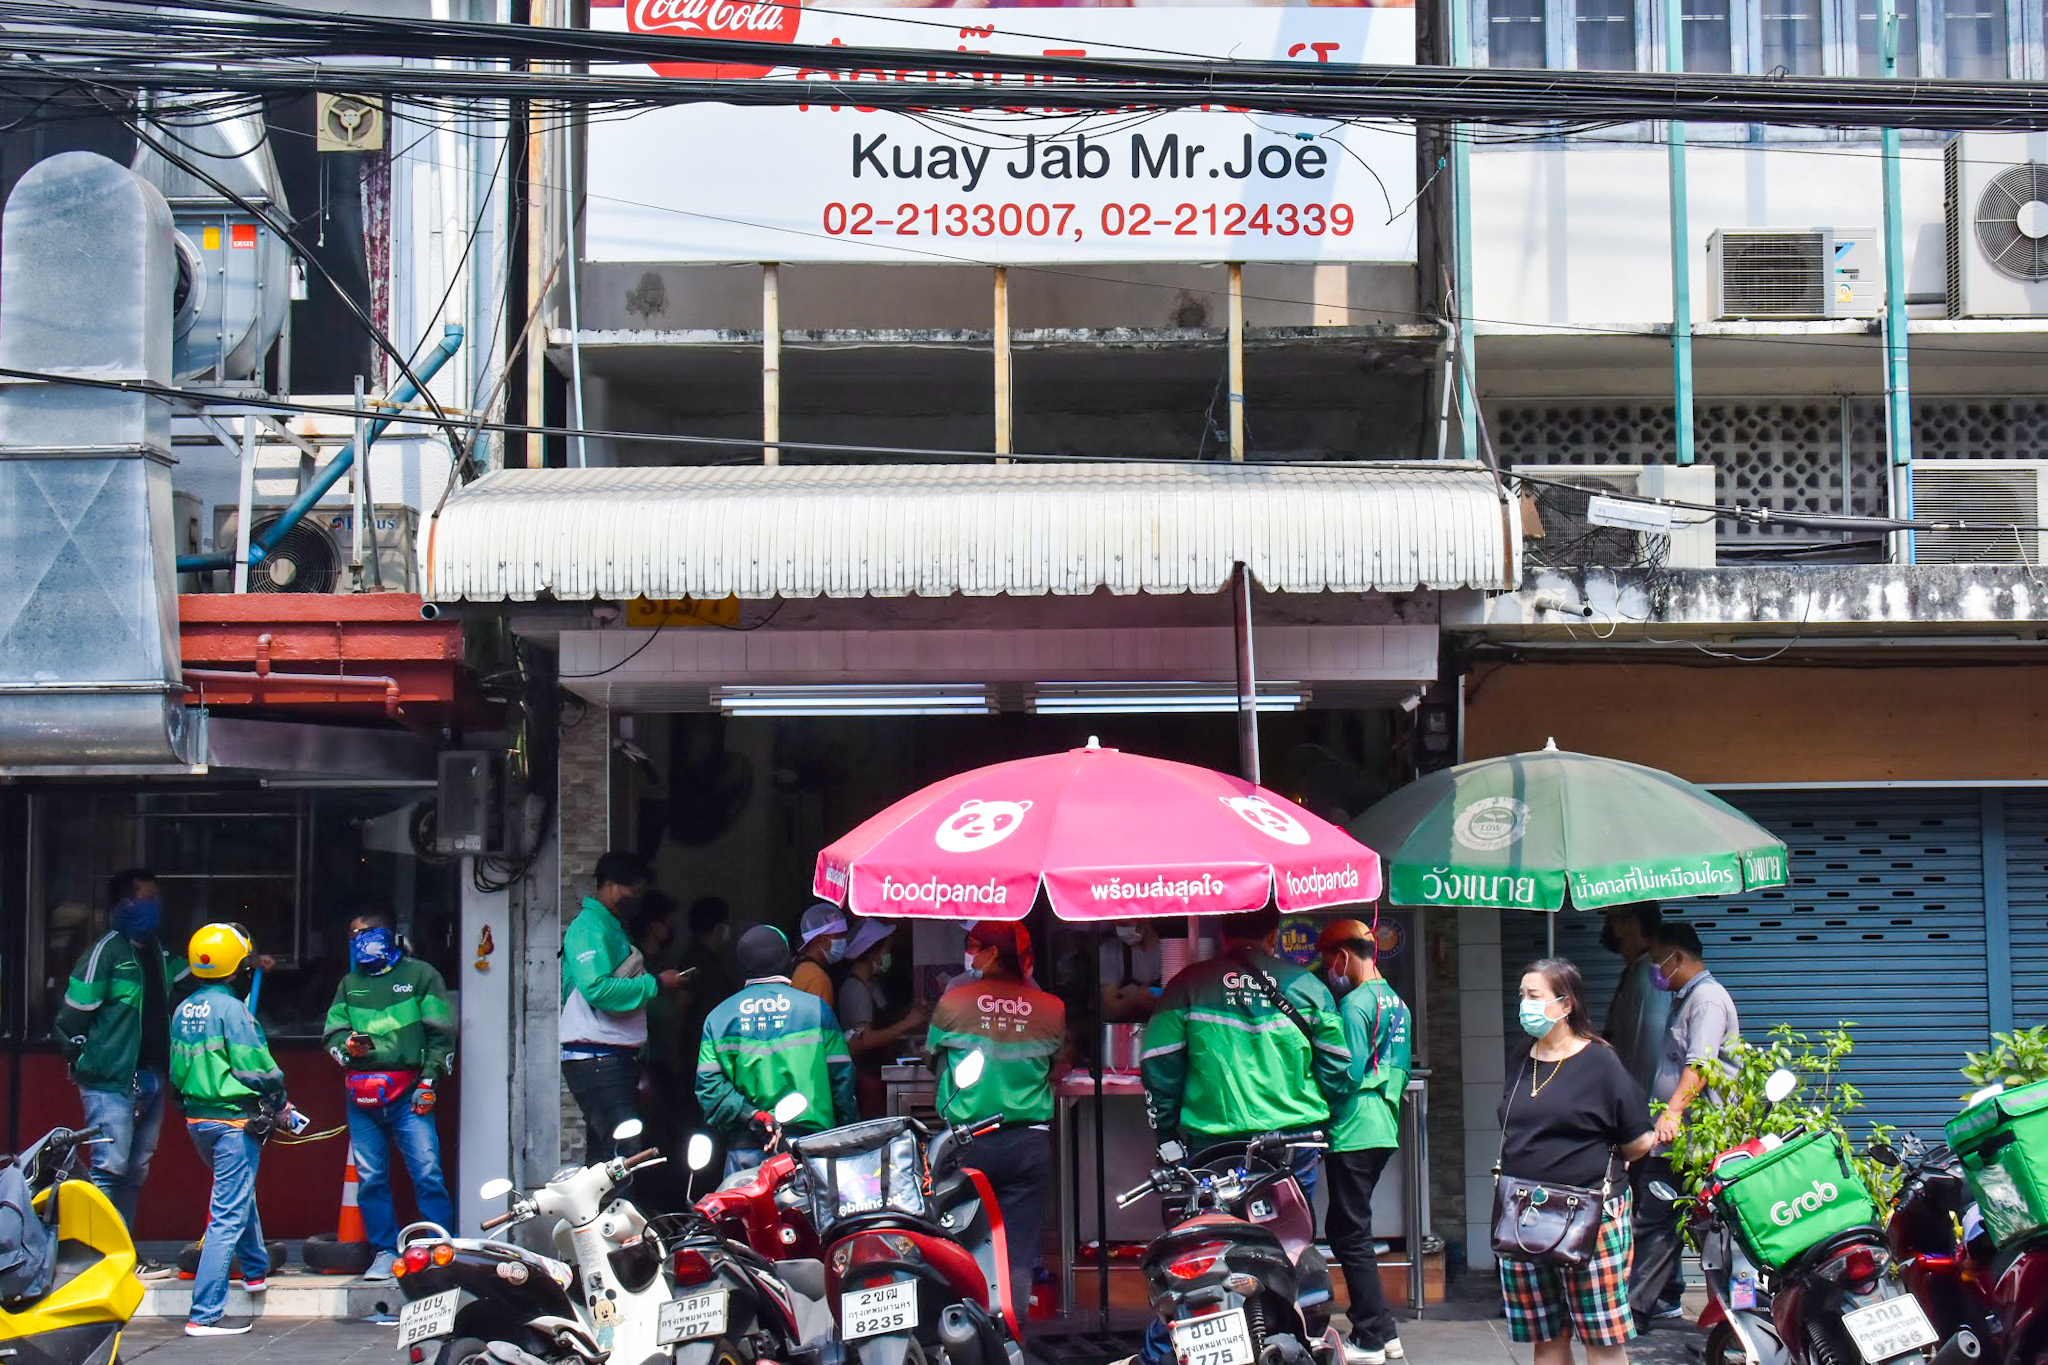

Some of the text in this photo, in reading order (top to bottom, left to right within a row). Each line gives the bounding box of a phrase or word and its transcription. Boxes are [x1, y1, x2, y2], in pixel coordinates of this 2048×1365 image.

[852, 133, 1327, 192] Kuay Jab Mr.Joe
[823, 203, 1354, 243] 02-2133007, 02-2124339
[346, 516, 396, 530] Fus
[1480, 824, 1502, 832] LOW
[1091, 873, 1224, 904] พร้อมส่งสุดใจ
[1286, 863, 1359, 898] foodpanda
[1576, 860, 1734, 899] น้ำตาลที่ไม่เหมือนใคร
[882, 875, 1007, 908] foodpanda
[393, 984, 413, 992] Grab
[1223, 970, 1277, 990] Grab
[182, 1000, 211, 1018] Grab
[740, 994, 790, 1014] Grab
[977, 994, 1032, 1016] Grab
[1770, 1180, 1838, 1226] Grab
[662, 1309, 722, 1327] กรุงเทพมหานคร
[849, 1301, 911, 1319] กรุงเทพมหานคร
[408, 1321, 438, 1341] 928
[674, 1321, 710, 1339] 707
[856, 1313, 904, 1333] 8235
[1181, 1335, 1244, 1356] กรุงเทพมหานคร
[1196, 1348, 1233, 1365] 775
